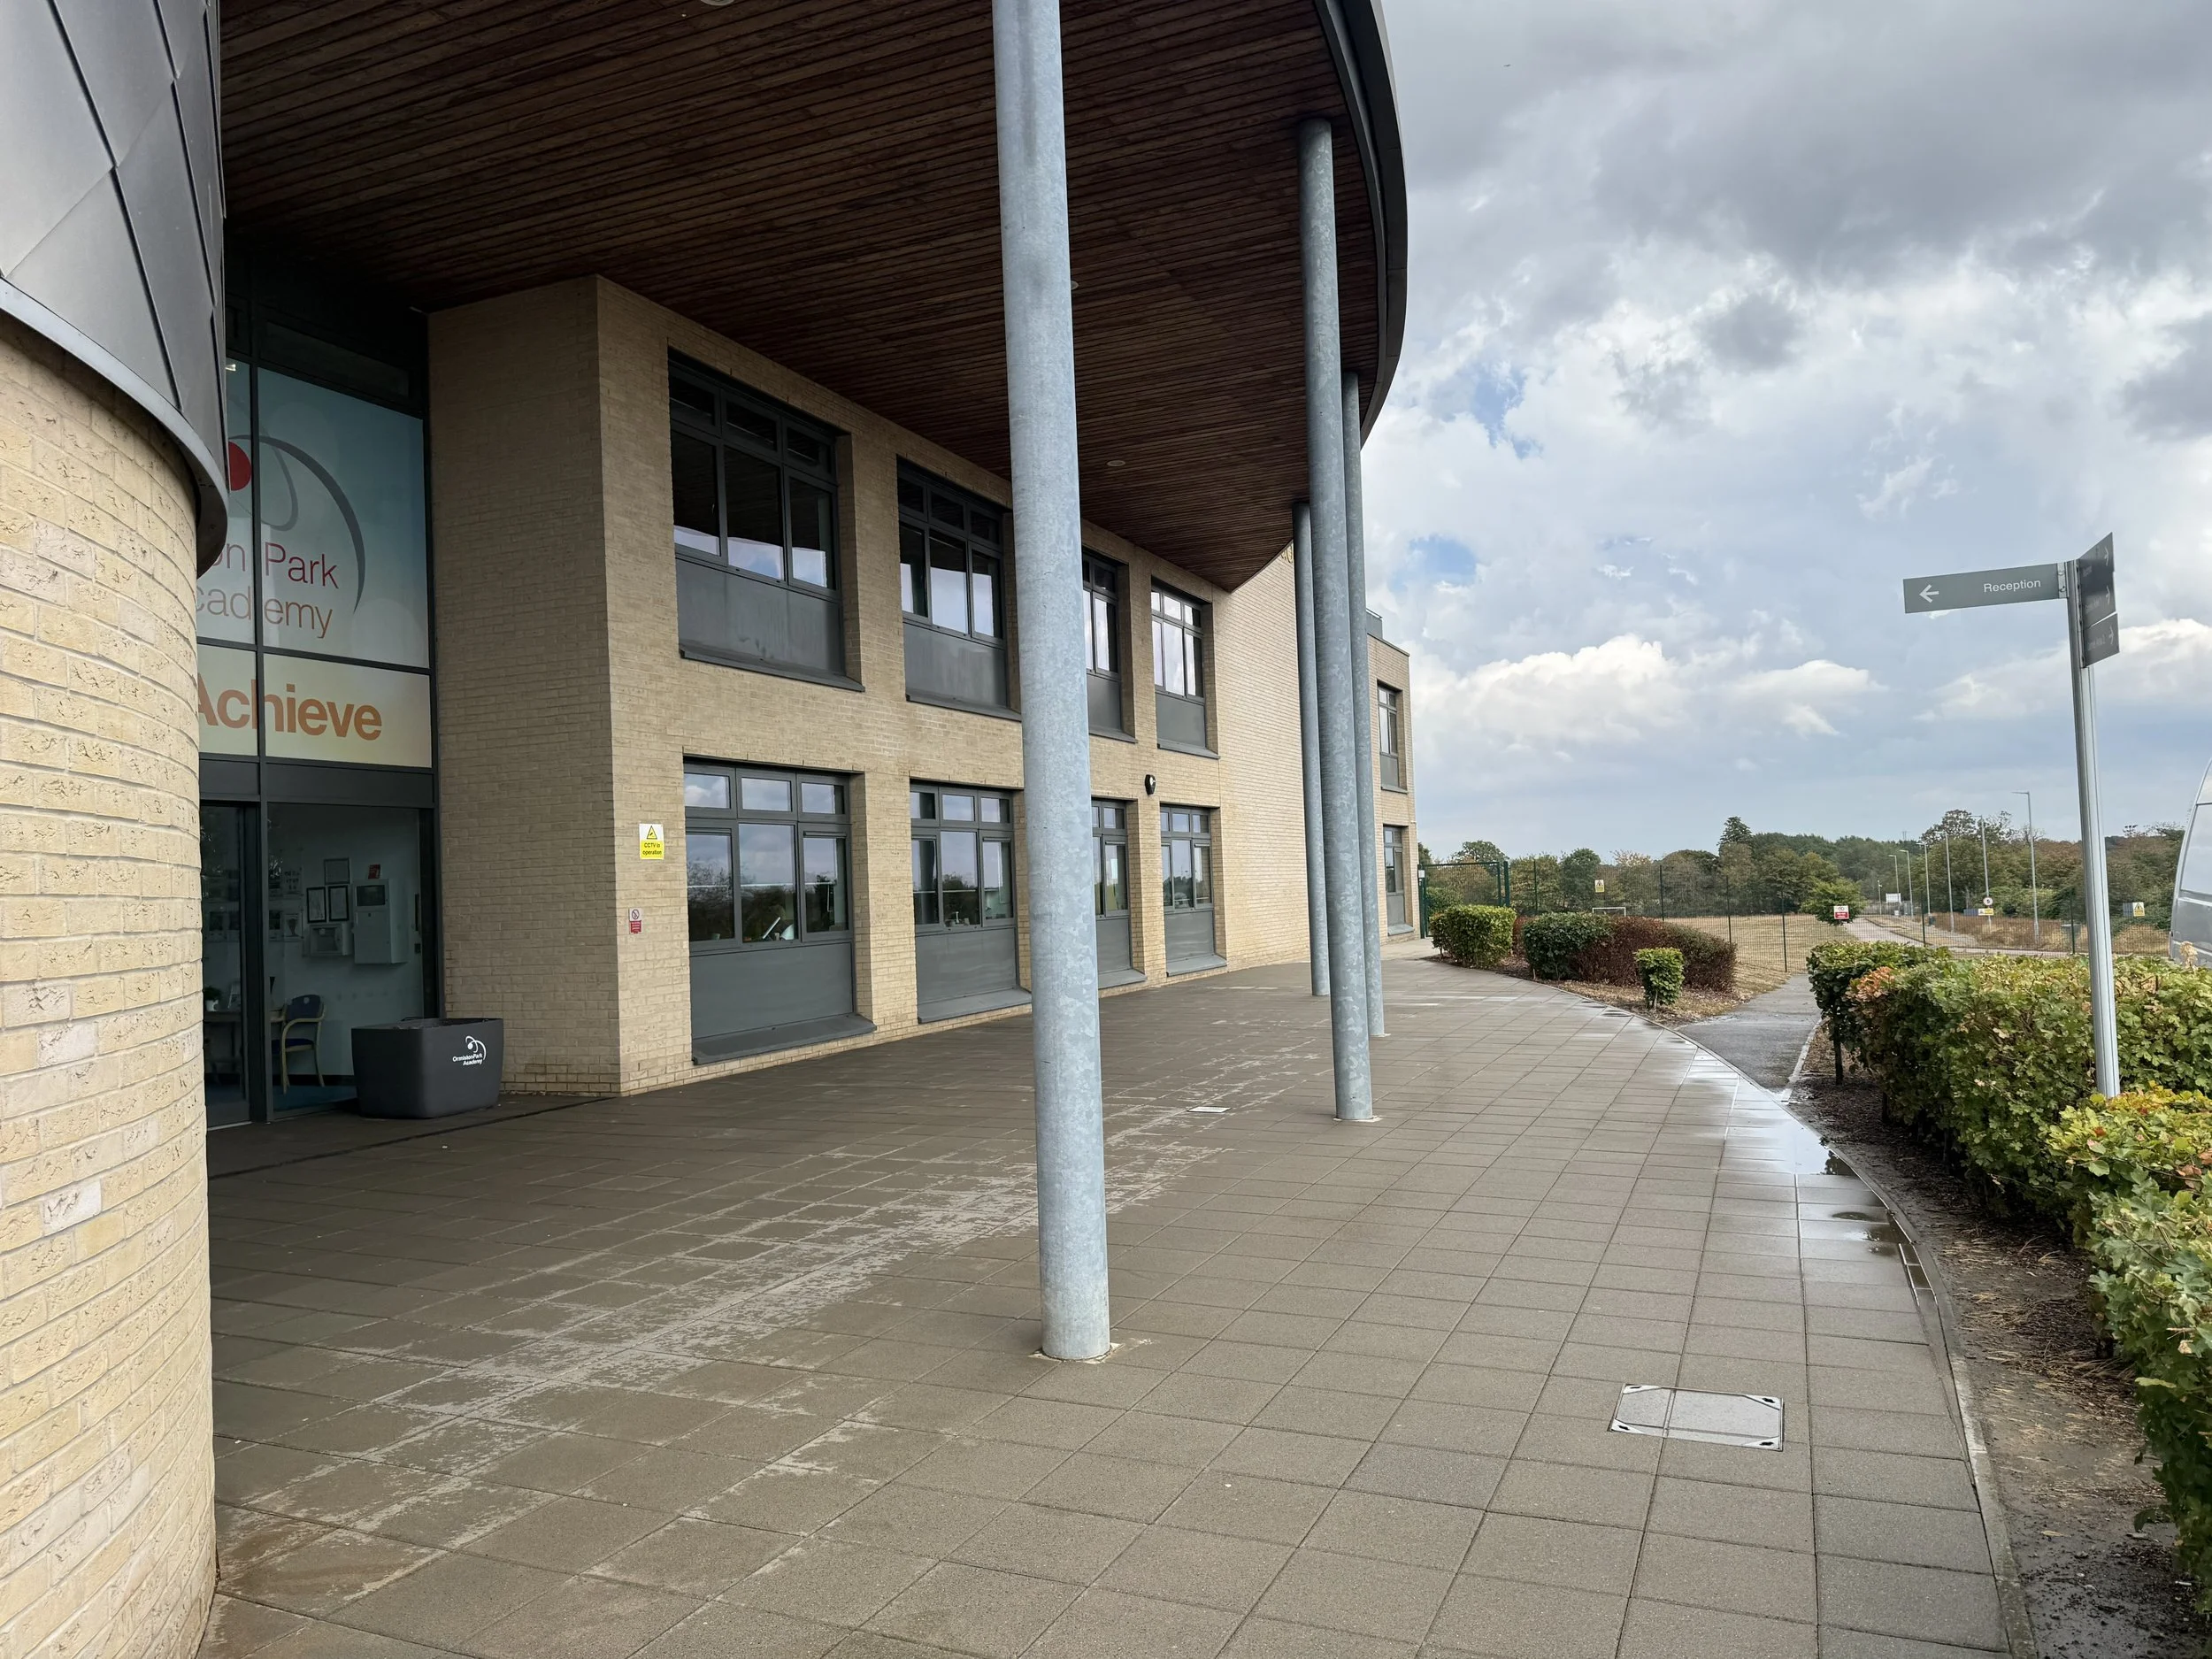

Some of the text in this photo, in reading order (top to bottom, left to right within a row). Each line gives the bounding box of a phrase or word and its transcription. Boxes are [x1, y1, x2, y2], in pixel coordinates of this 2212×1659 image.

[265, 541, 339, 589] Park
[1984, 580, 2041, 592] Reception
[198, 672, 382, 741] Achieve
